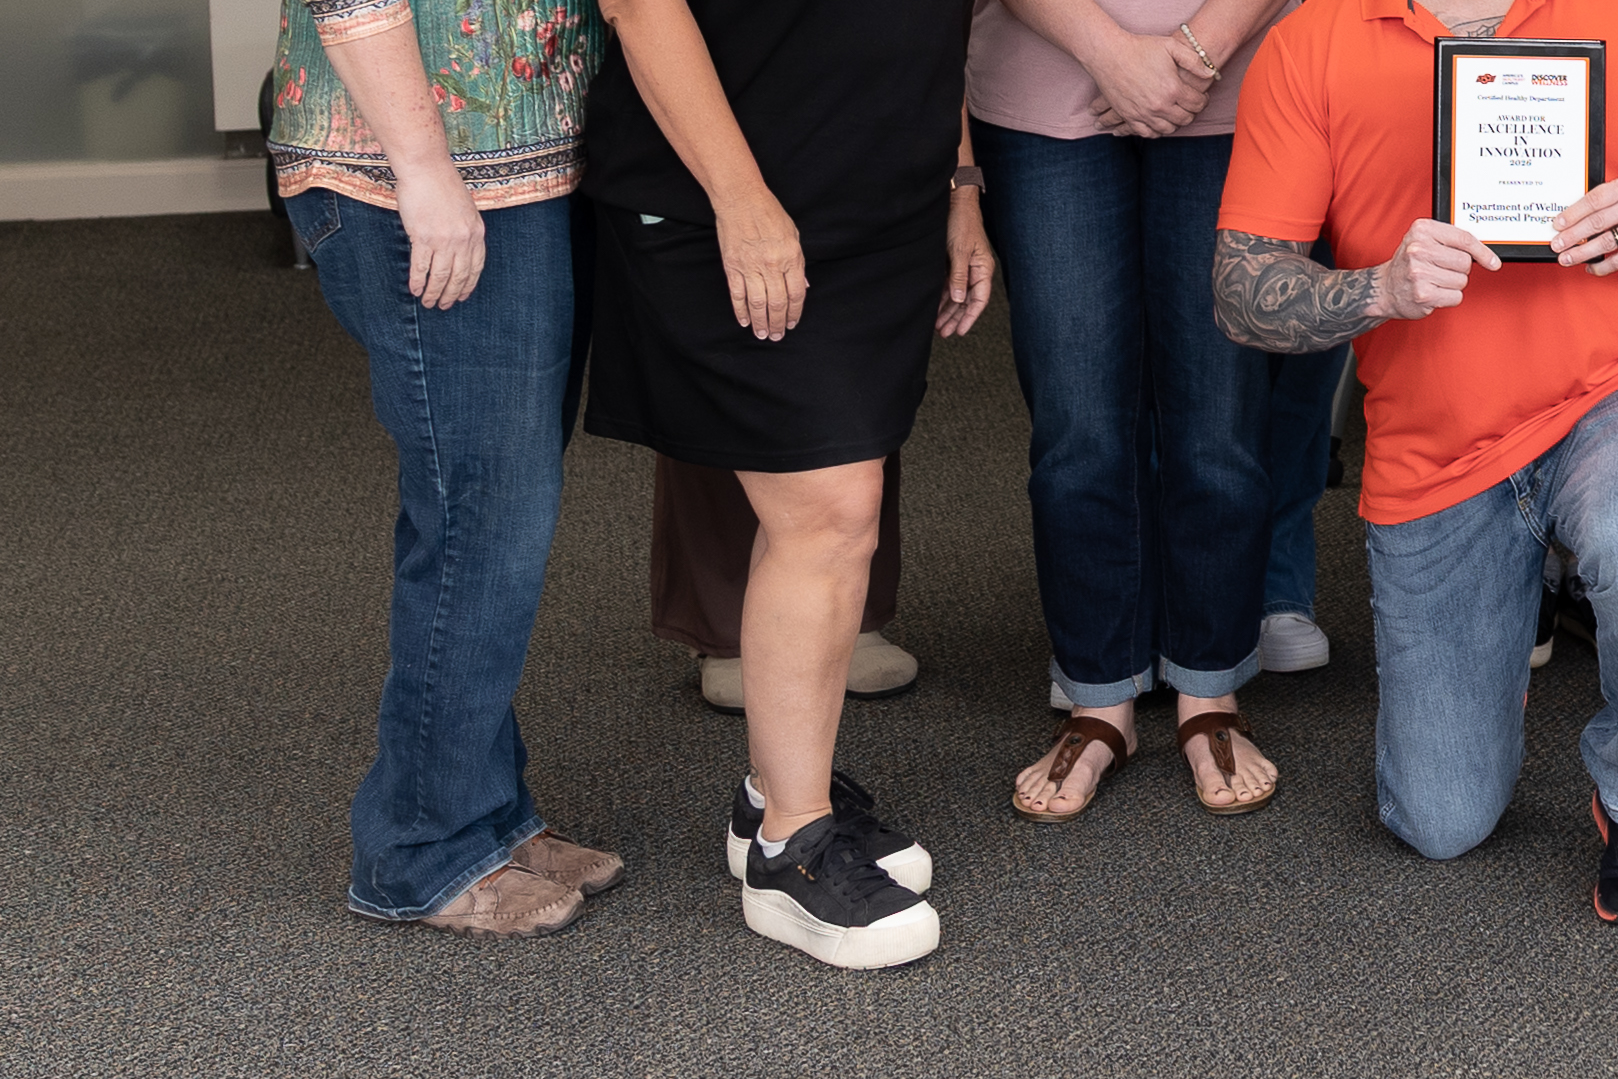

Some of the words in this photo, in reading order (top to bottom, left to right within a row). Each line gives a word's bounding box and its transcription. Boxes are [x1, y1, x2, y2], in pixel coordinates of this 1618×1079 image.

[1531, 73, 1568, 81] DISCOVER
[1531, 79, 1568, 87] WELLNESS
[1529, 95, 1565, 103] Department
[1497, 114, 1528, 122] AWARD
[1529, 114, 1546, 122] FOR
[1478, 123, 1565, 134] EXCELLENCE
[1514, 135, 1528, 146] IN
[1479, 147, 1562, 158] INNOVATION
[1509, 159, 1532, 167] 2026
[1462, 202, 1521, 213] Department
[1523, 202, 1534, 212] of
[1469, 213, 1521, 224] Sponsored
